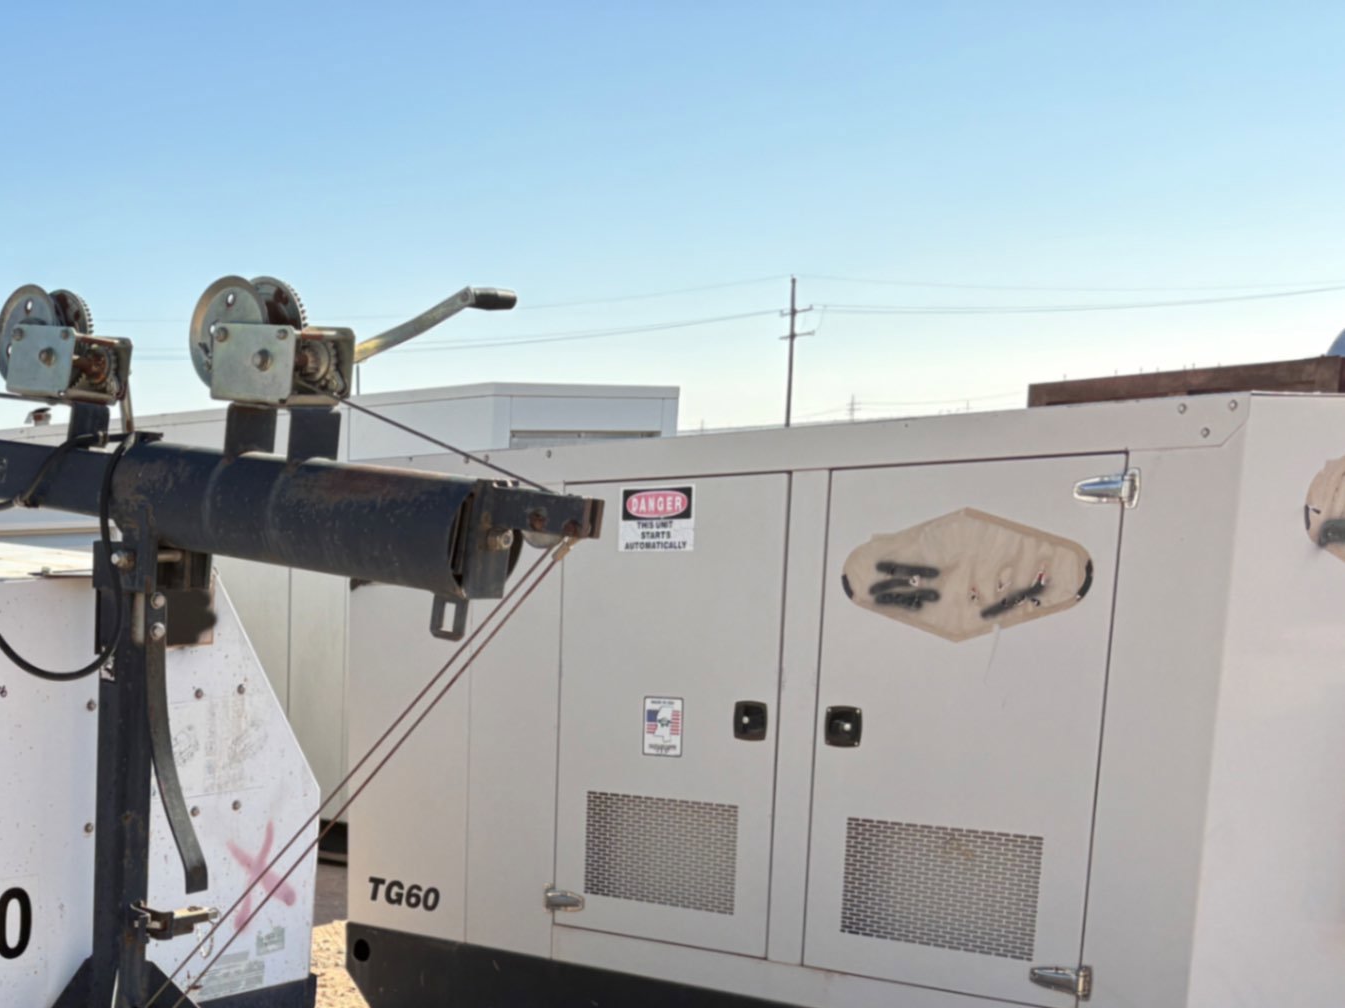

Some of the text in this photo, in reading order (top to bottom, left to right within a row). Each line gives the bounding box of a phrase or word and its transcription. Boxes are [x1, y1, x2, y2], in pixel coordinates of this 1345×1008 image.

[631, 495, 683, 513] DANGER
[636, 520, 673, 530] THIS UNIT
[640, 530, 672, 540] STARTS
[624, 541, 688, 550] AUTOMATICALLY
[368, 876, 440, 912] TG60
